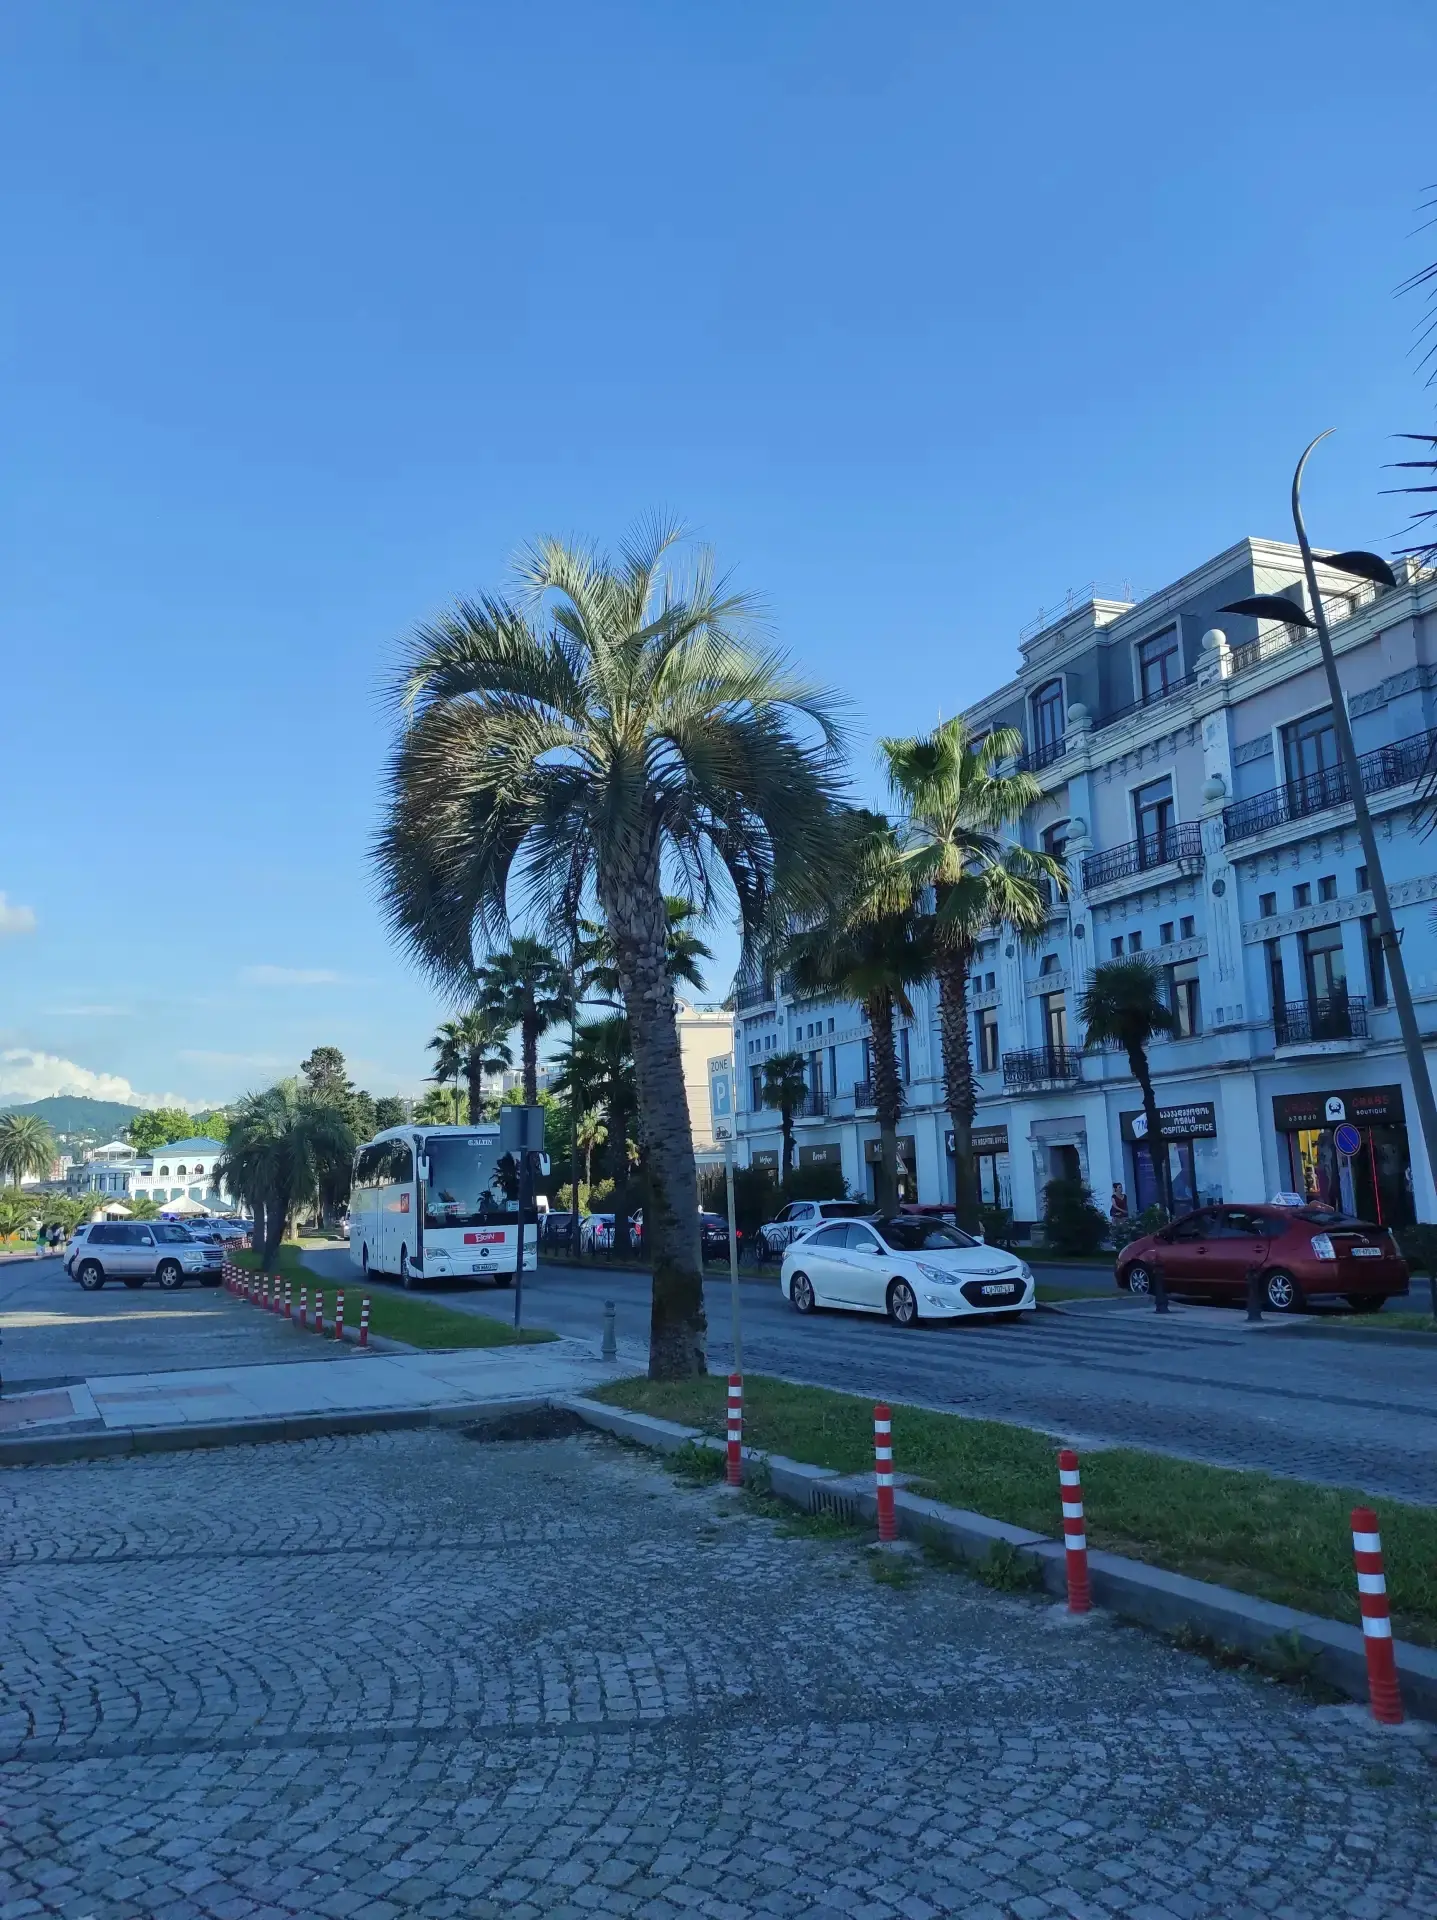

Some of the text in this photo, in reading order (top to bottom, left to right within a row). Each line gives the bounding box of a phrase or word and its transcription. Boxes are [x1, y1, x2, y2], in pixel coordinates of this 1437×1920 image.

[711, 1059, 728, 1072] ZONE
[716, 1082, 726, 1110] P
[1356, 1108, 1387, 1116] BOUTIQUE
[1190, 1123, 1214, 1132] OFFICE
